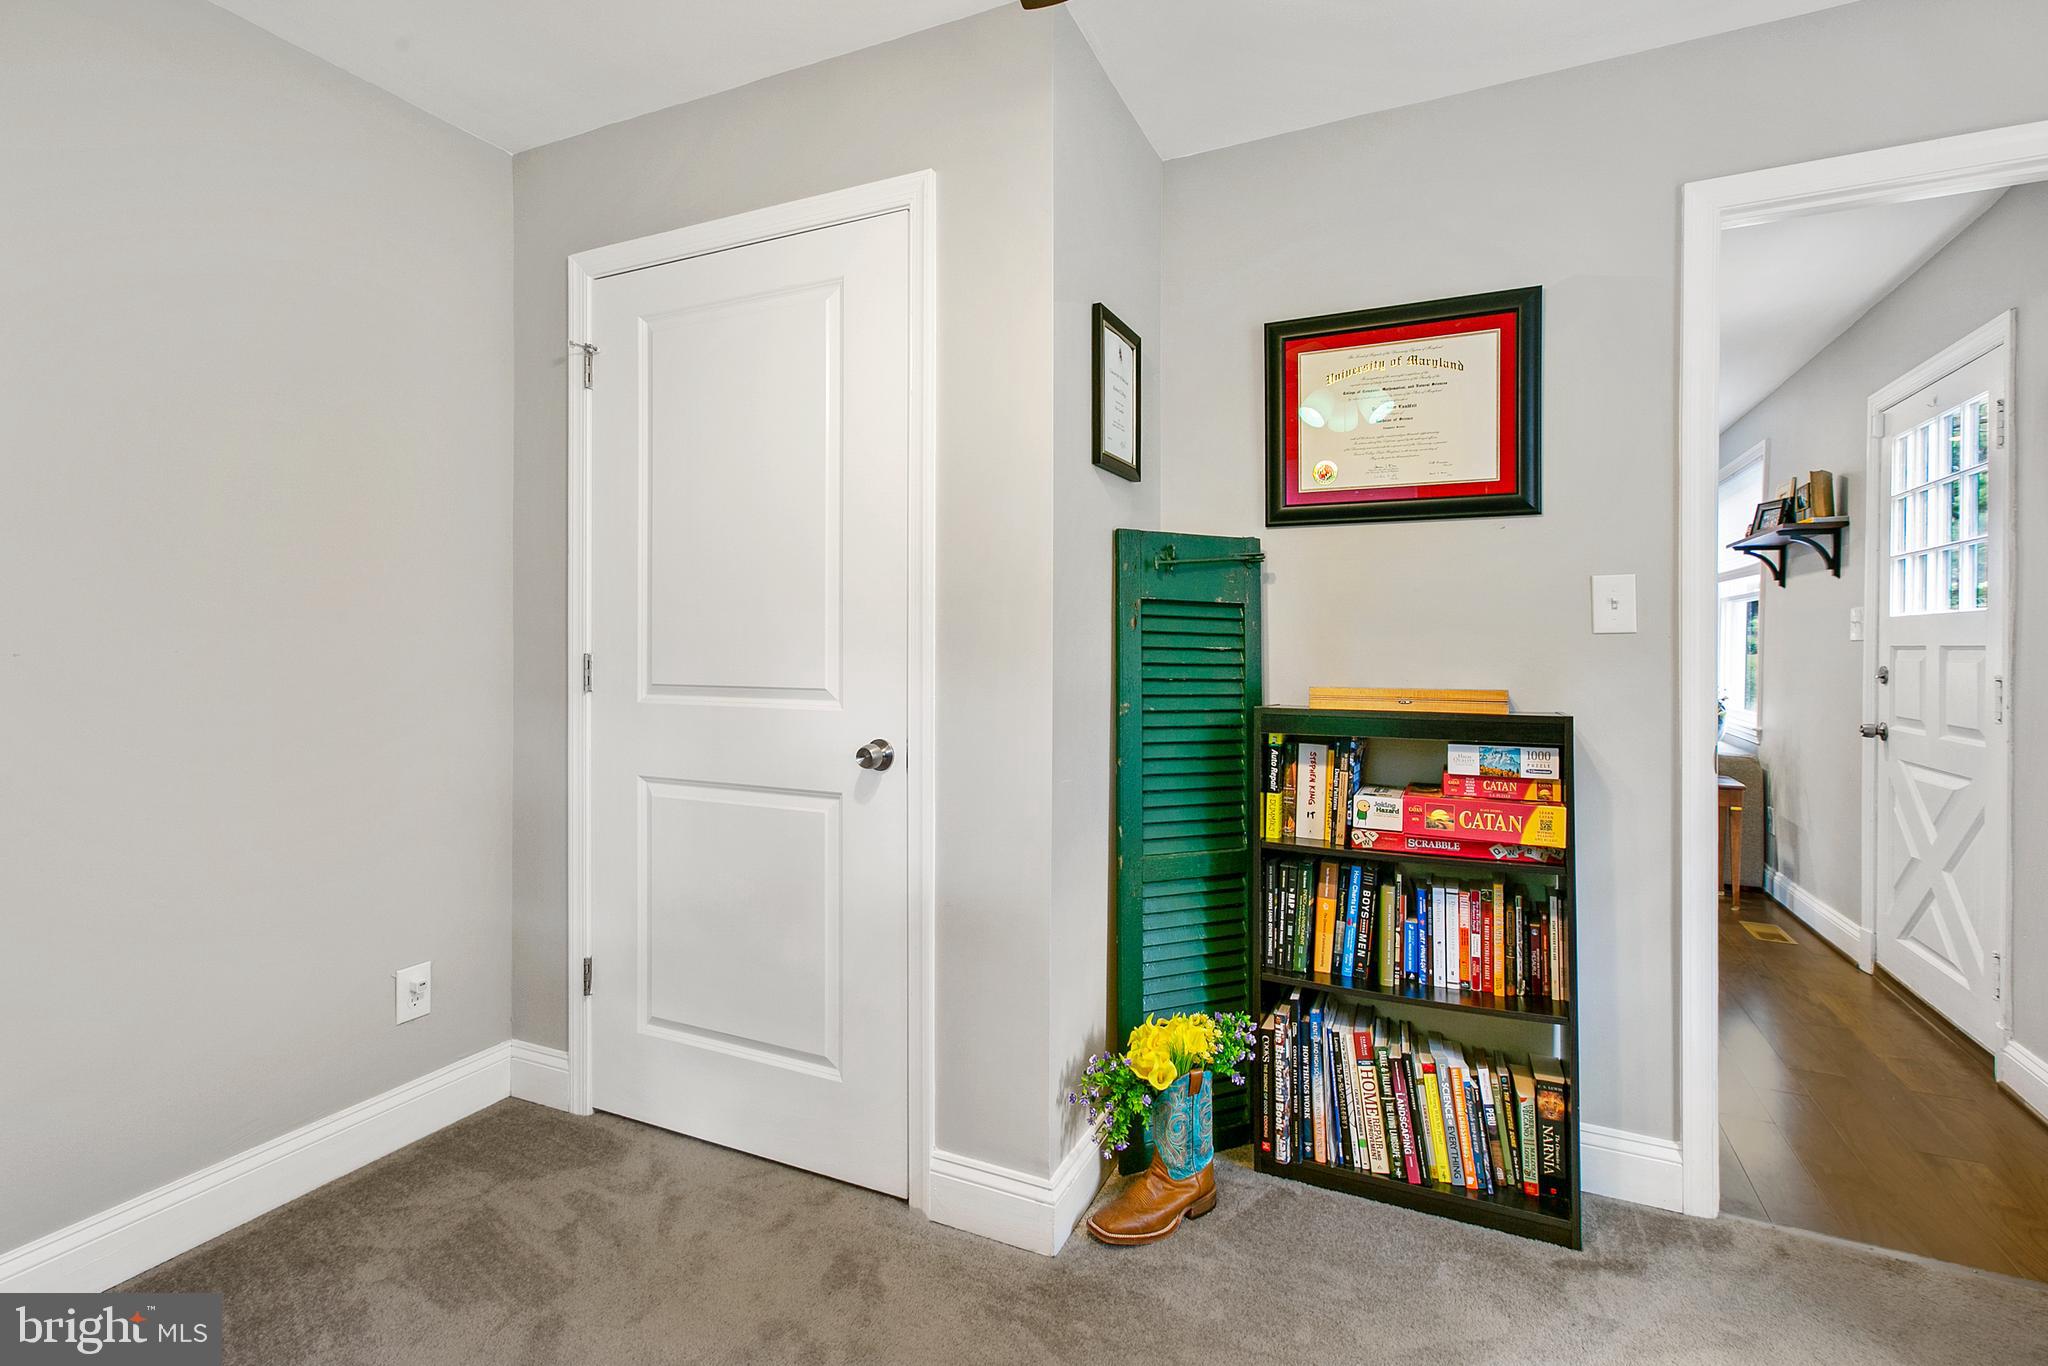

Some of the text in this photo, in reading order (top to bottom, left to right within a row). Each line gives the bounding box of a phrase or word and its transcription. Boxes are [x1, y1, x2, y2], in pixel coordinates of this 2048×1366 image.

[1326, 360, 1385, 385] University
[1391, 356, 1402, 366] of
[1407, 355, 1464, 371] Maryland
[1527, 751, 1551, 760] 1000
[1270, 767, 1279, 791] Repair
[1483, 780, 1517, 791] CATAN
[1459, 810, 1523, 833] CATAN
[1408, 839, 1460, 850] SCRABBLE
[1361, 890, 1371, 919] BOYS
[1357, 933, 1367, 957] MEN
[1262, 1035, 1270, 1063] COOK'S
[1378, 1050, 1387, 1067] DARKE
[1275, 1023, 1285, 1130] The Basketball Book
[1360, 1068, 1378, 1117] HOME
[1372, 1118, 1383, 1150] REPAIR
[1452, 1069, 1462, 1095] ULTIMATE
[1458, 1116, 1469, 1158] CROSSWORDS
[1466, 1100, 1476, 1122] Spanish
[1486, 1108, 1496, 1126] PERU
[1505, 1102, 1514, 1130] ADVENTURE
[1385, 1103, 1400, 1158] THE LIVING LANDSCAPE
[1396, 1092, 1411, 1155] LANDSCAPING
[1441, 1082, 1453, 1120] SCIENCE
[1447, 1126, 1461, 1179] EVERYTHING
[1470, 1122, 1479, 1153] STEP-BY-STEP
[1366, 1117, 1377, 1161] IMPROVEMENT
[1542, 1125, 1555, 1175] NARNIA
